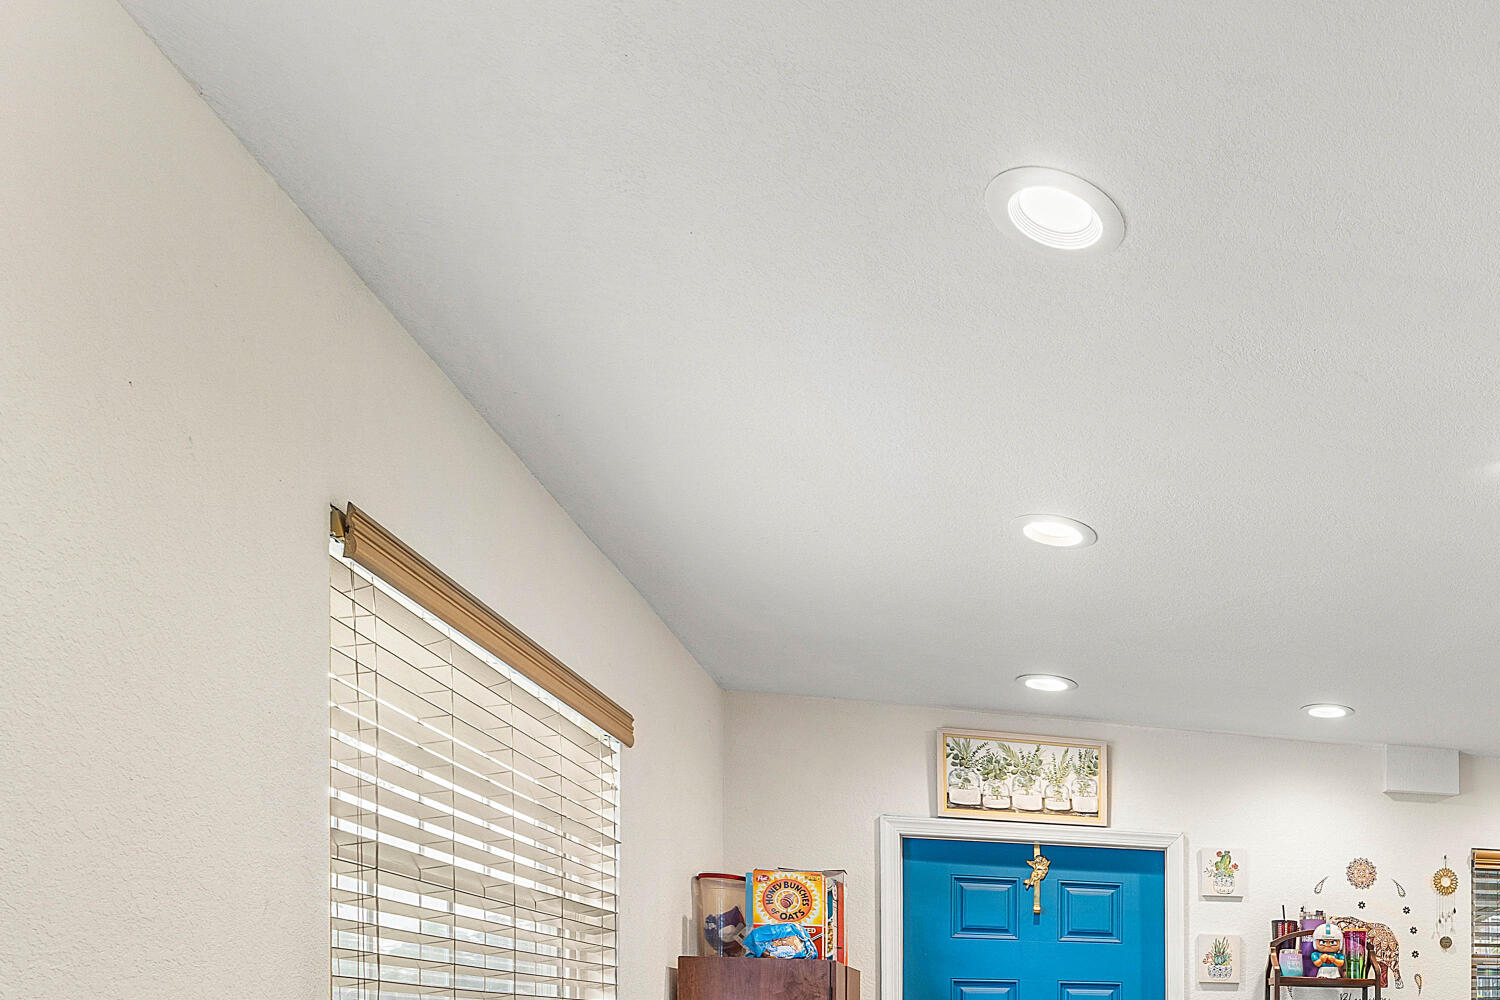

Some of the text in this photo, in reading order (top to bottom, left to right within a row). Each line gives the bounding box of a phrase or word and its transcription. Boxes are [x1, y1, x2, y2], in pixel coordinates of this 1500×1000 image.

[765, 881, 810, 907] HONEY BUNCHES
[780, 909, 805, 920] OATS
